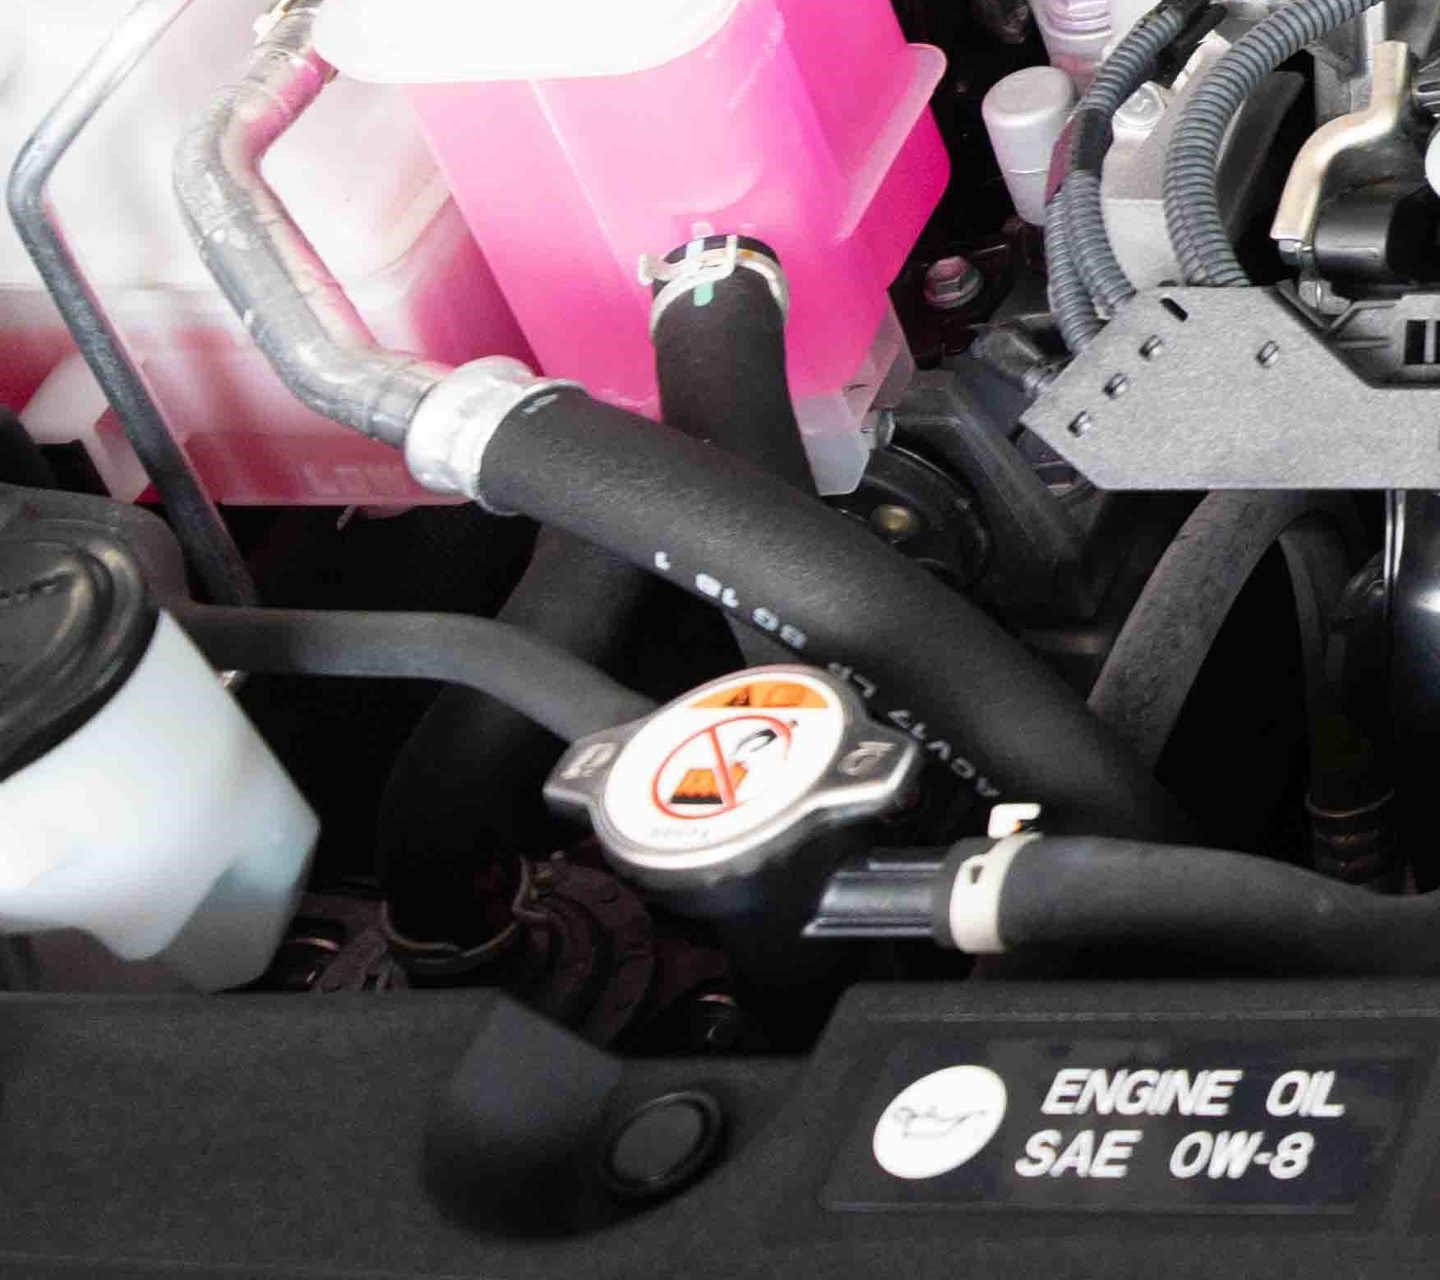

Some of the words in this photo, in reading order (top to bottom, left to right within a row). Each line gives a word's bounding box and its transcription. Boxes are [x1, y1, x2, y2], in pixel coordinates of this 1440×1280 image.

[1040, 1068, 1243, 1118] ENGINE
[1265, 1070, 1345, 1119] OIL
[1014, 1128, 1143, 1180] SAE
[1169, 1130, 1315, 1180] 0W-8
